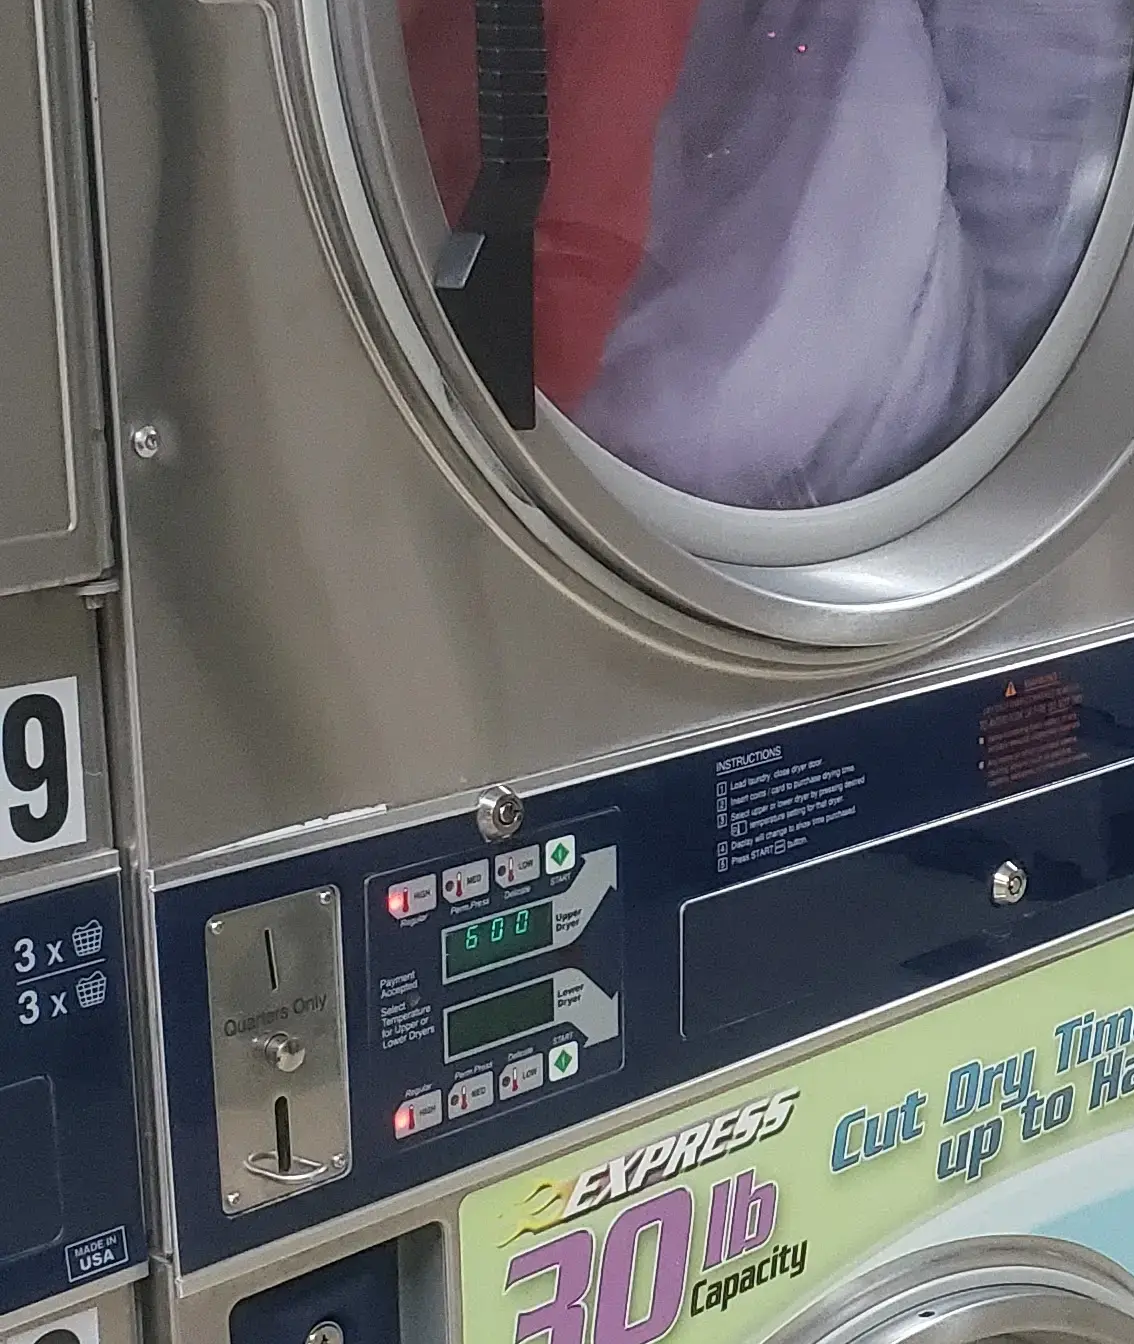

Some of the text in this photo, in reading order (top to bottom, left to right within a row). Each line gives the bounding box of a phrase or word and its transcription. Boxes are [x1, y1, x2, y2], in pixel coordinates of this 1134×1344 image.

[716, 745, 782, 773] INSTRUCTIONS
[556, 908, 582, 922] Upper
[556, 918, 580, 932] Dryer
[465, 909, 529, 950] 600
[14, 938, 64, 972] 3 x
[380, 970, 416, 990] Payment
[380, 980, 418, 1000] Accepted
[557, 983, 584, 998] Lower
[18, 990, 68, 1024] 3 x
[380, 1002, 406, 1018] Select
[557, 994, 582, 1008] Dryer
[224, 993, 327, 1037] Quarters Only
[381, 1005, 431, 1026] Temperature
[382, 1026, 436, 1050] Lower Dryers
[396, 1020, 418, 1036] Upper
[830, 1089, 928, 1174] Cut
[942, 1047, 1036, 1126] Dry
[936, 1117, 1002, 1182] up
[1020, 1084, 1076, 1142] to
[562, 1086, 800, 1220] EXPRESS
[702, 1168, 778, 1272] lb
[74, 1235, 117, 1257] MADE IN
[80, 1248, 115, 1270] USA
[690, 1240, 807, 1317] Capacity
